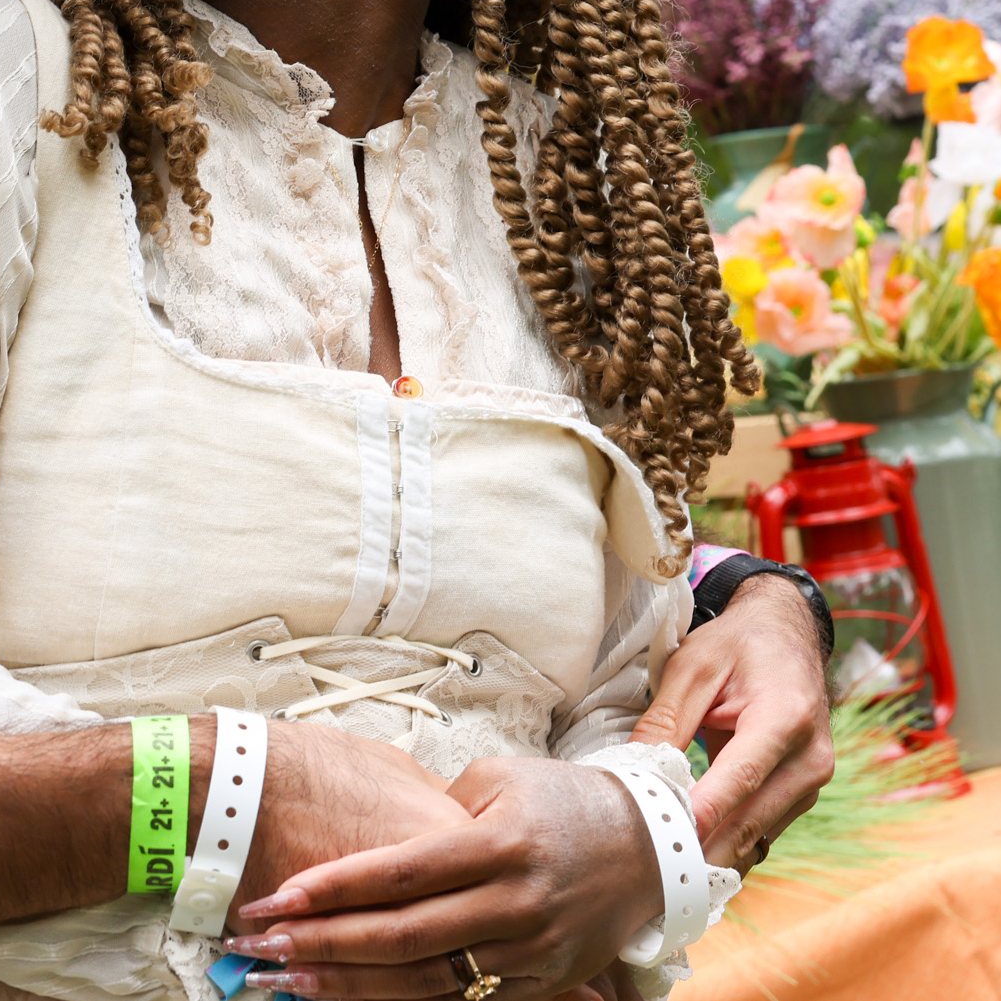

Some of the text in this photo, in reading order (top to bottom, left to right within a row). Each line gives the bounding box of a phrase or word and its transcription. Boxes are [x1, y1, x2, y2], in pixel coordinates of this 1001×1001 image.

[152, 726, 174, 751] 21+
[152, 756, 174, 789] 21+
[150, 798, 173, 831] 21+
